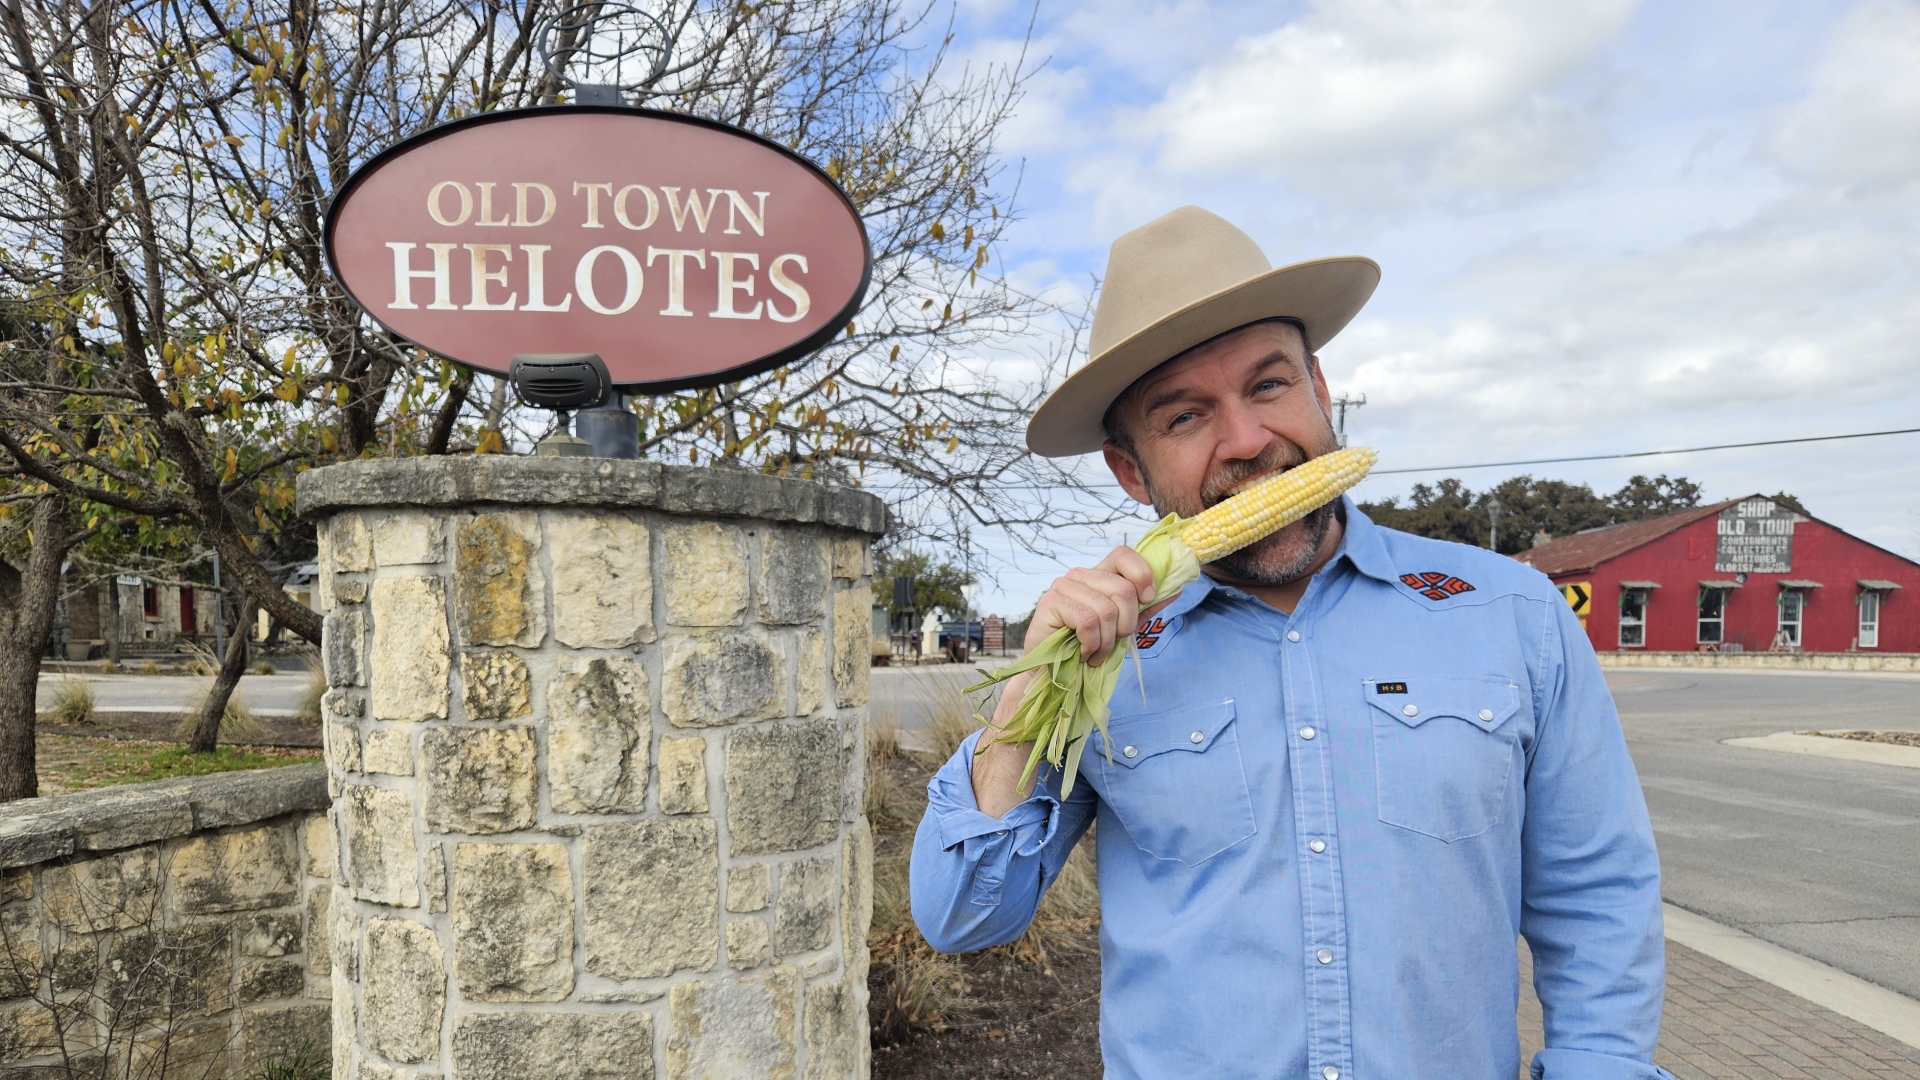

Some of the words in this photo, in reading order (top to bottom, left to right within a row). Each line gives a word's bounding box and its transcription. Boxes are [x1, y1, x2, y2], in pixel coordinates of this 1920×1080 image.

[427, 180, 557, 227] OLD
[573, 181, 771, 237] TOWN
[385, 241, 811, 324] HELOTES
[1738, 501, 1776, 517] SHOP
[1717, 519, 1745, 535] OLD
[1757, 519, 1794, 535] TOWN
[1721, 536, 1788, 545] CONSIGNMENTS
[1721, 545, 1788, 554] COLLECTIBLES
[1732, 554, 1777, 563] ANTIQUES
